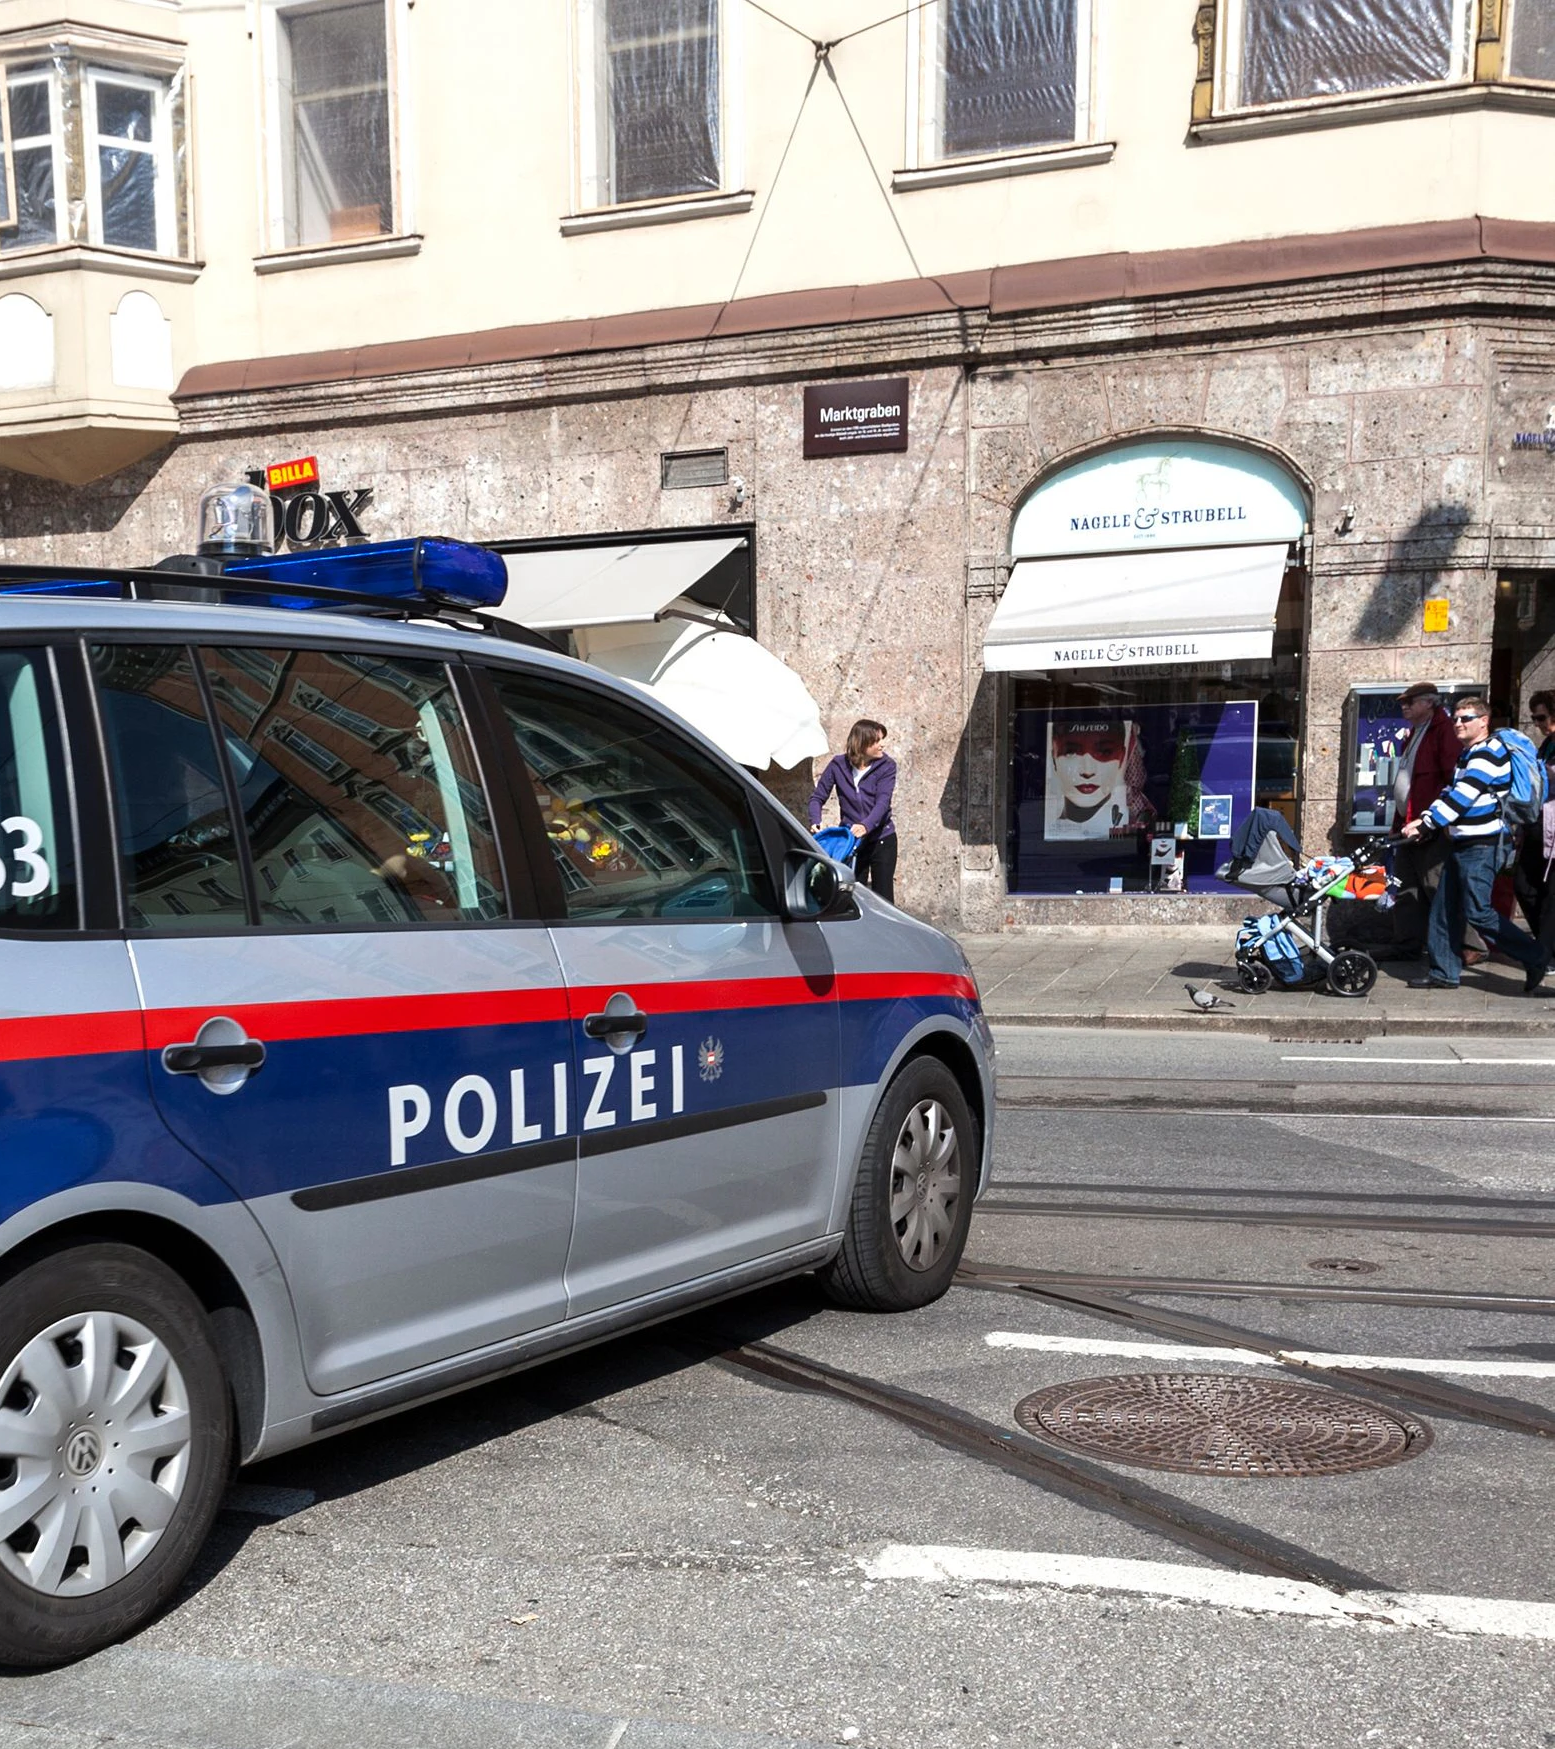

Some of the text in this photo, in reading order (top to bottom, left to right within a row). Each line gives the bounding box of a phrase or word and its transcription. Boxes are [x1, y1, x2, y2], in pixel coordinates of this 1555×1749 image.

[820, 403, 901, 423] Marktgraben
[269, 461, 314, 485] BILLA
[1134, 507, 1159, 530] &
[1160, 506, 1247, 525] STRUBELL
[1106, 643, 1128, 662] &
[1128, 643, 1199, 658] STRUBELL
[1069, 723, 1109, 733] SHISEIDO
[388, 1045, 684, 1167] POLIZEI
